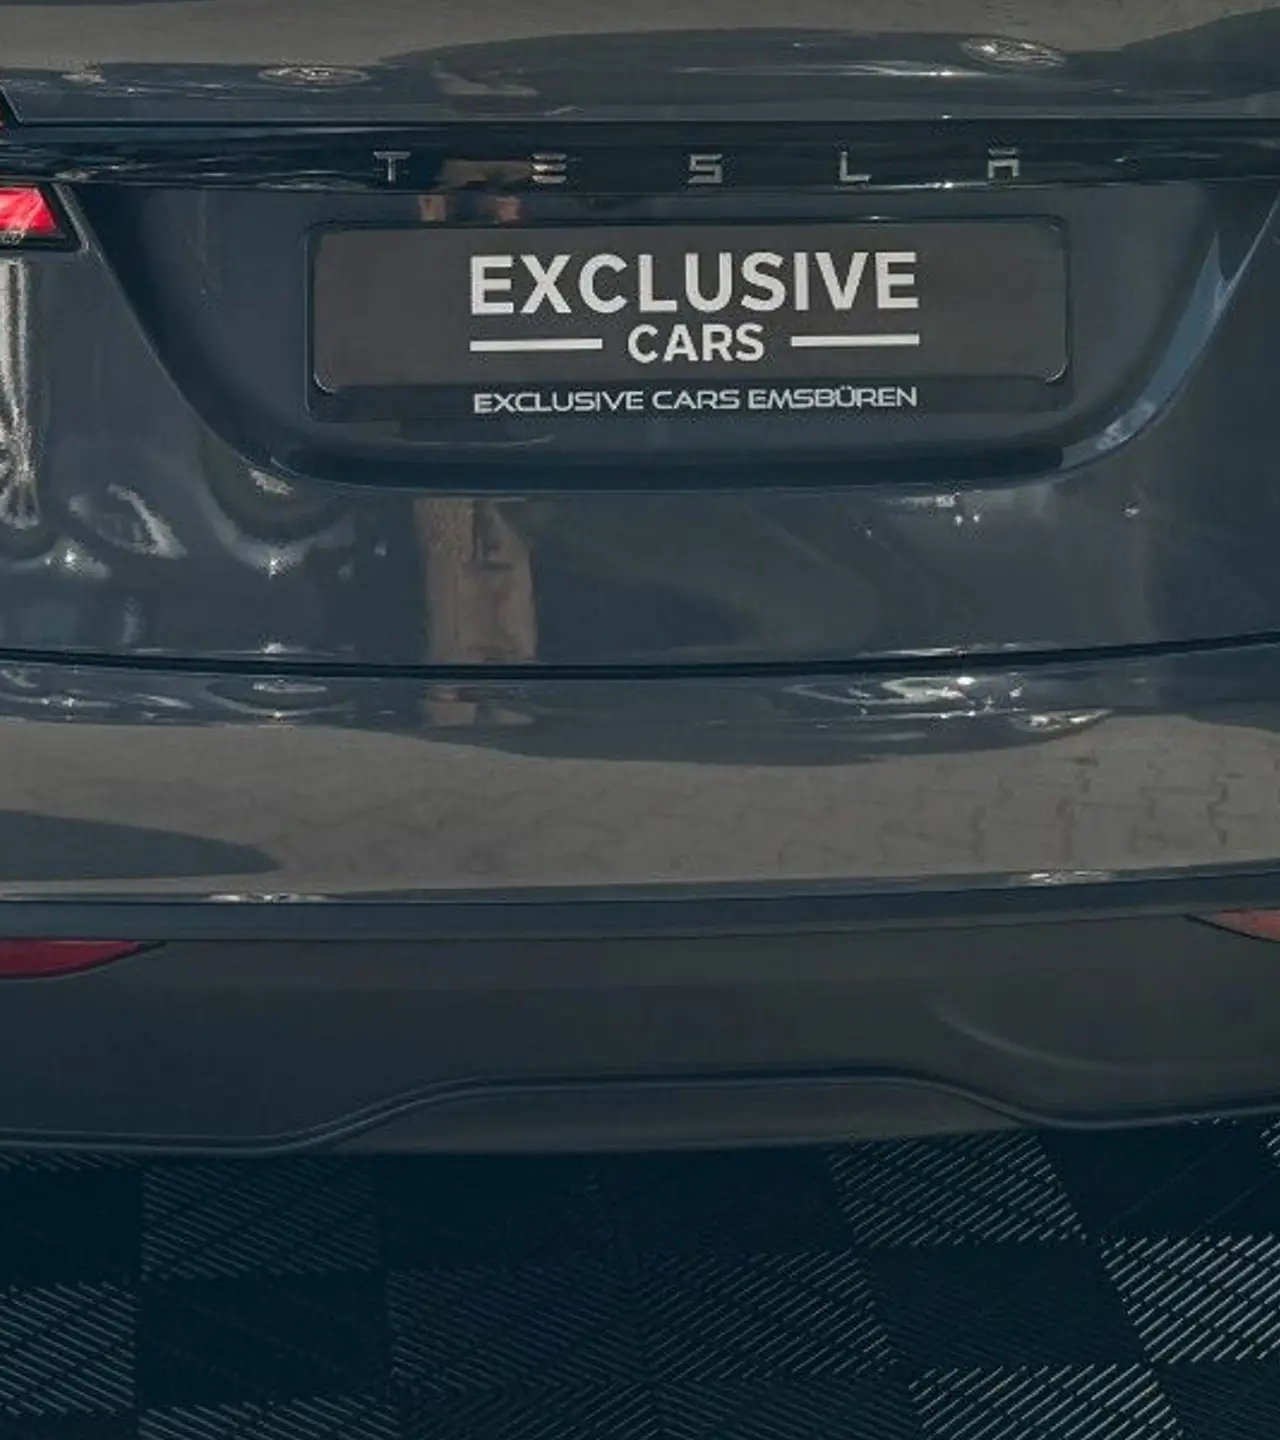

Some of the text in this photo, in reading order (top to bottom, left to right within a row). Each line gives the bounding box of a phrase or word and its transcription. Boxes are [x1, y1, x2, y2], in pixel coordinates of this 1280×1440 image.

[372, 147, 1021, 185] TESLA
[470, 251, 920, 315] EXCLUSIVE
[626, 322, 766, 364] CARS
[473, 384, 918, 414] EXCLUSIVE CARS EMSBÜREN
